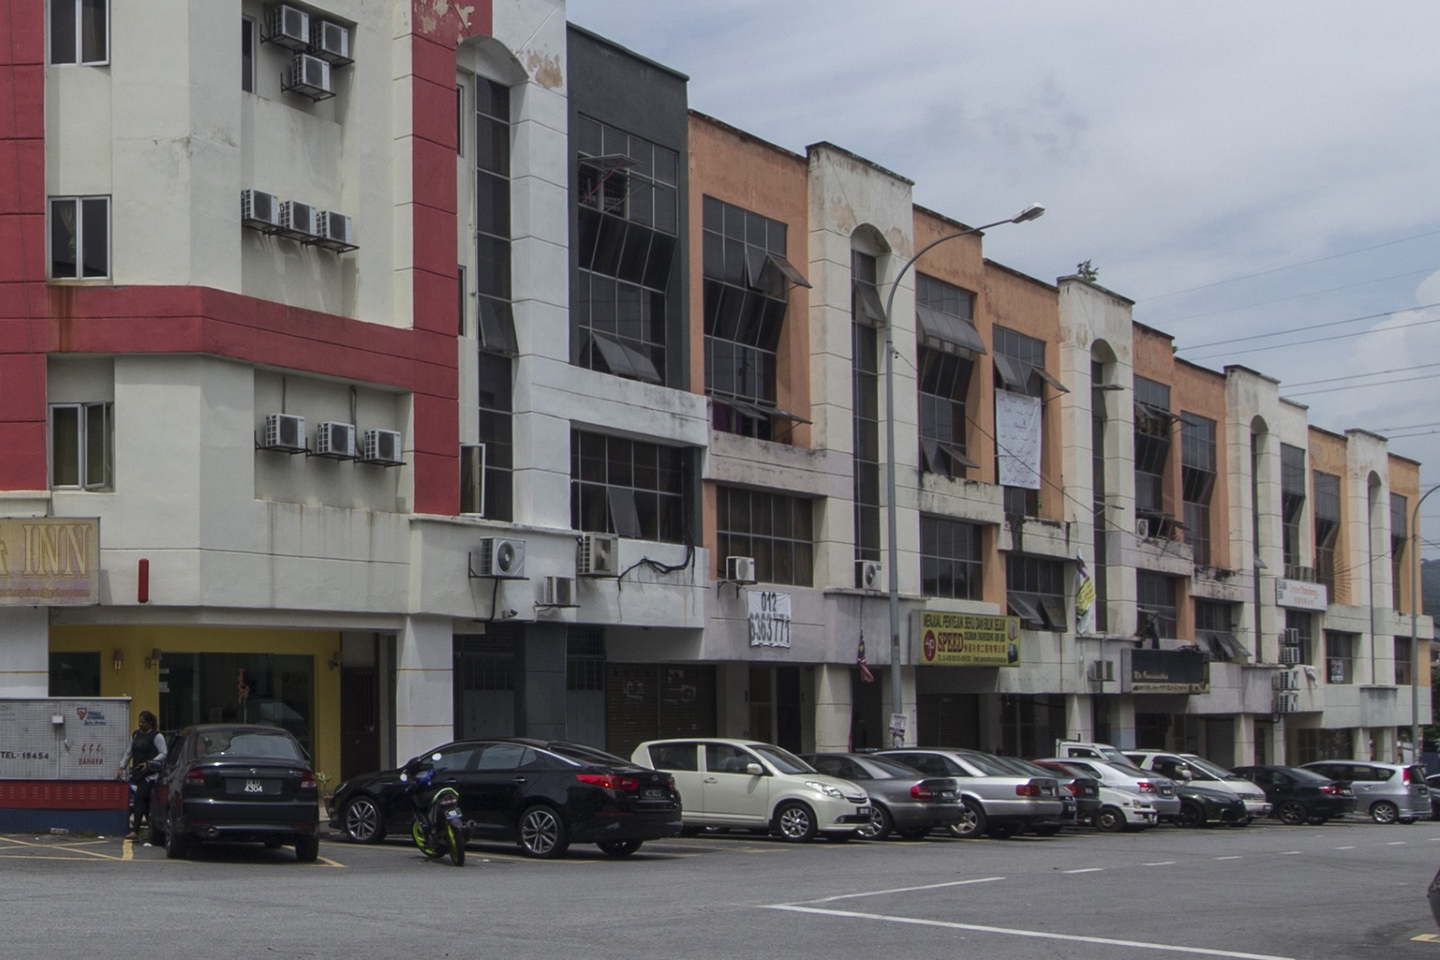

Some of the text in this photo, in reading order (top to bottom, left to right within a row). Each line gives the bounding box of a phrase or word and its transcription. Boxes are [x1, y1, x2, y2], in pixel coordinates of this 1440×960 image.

[22, 523, 92, 578] INN
[761, 591, 776, 611] 012
[938, 631, 964, 652] SPEED
[78, 758, 103, 766] BAHAYA
